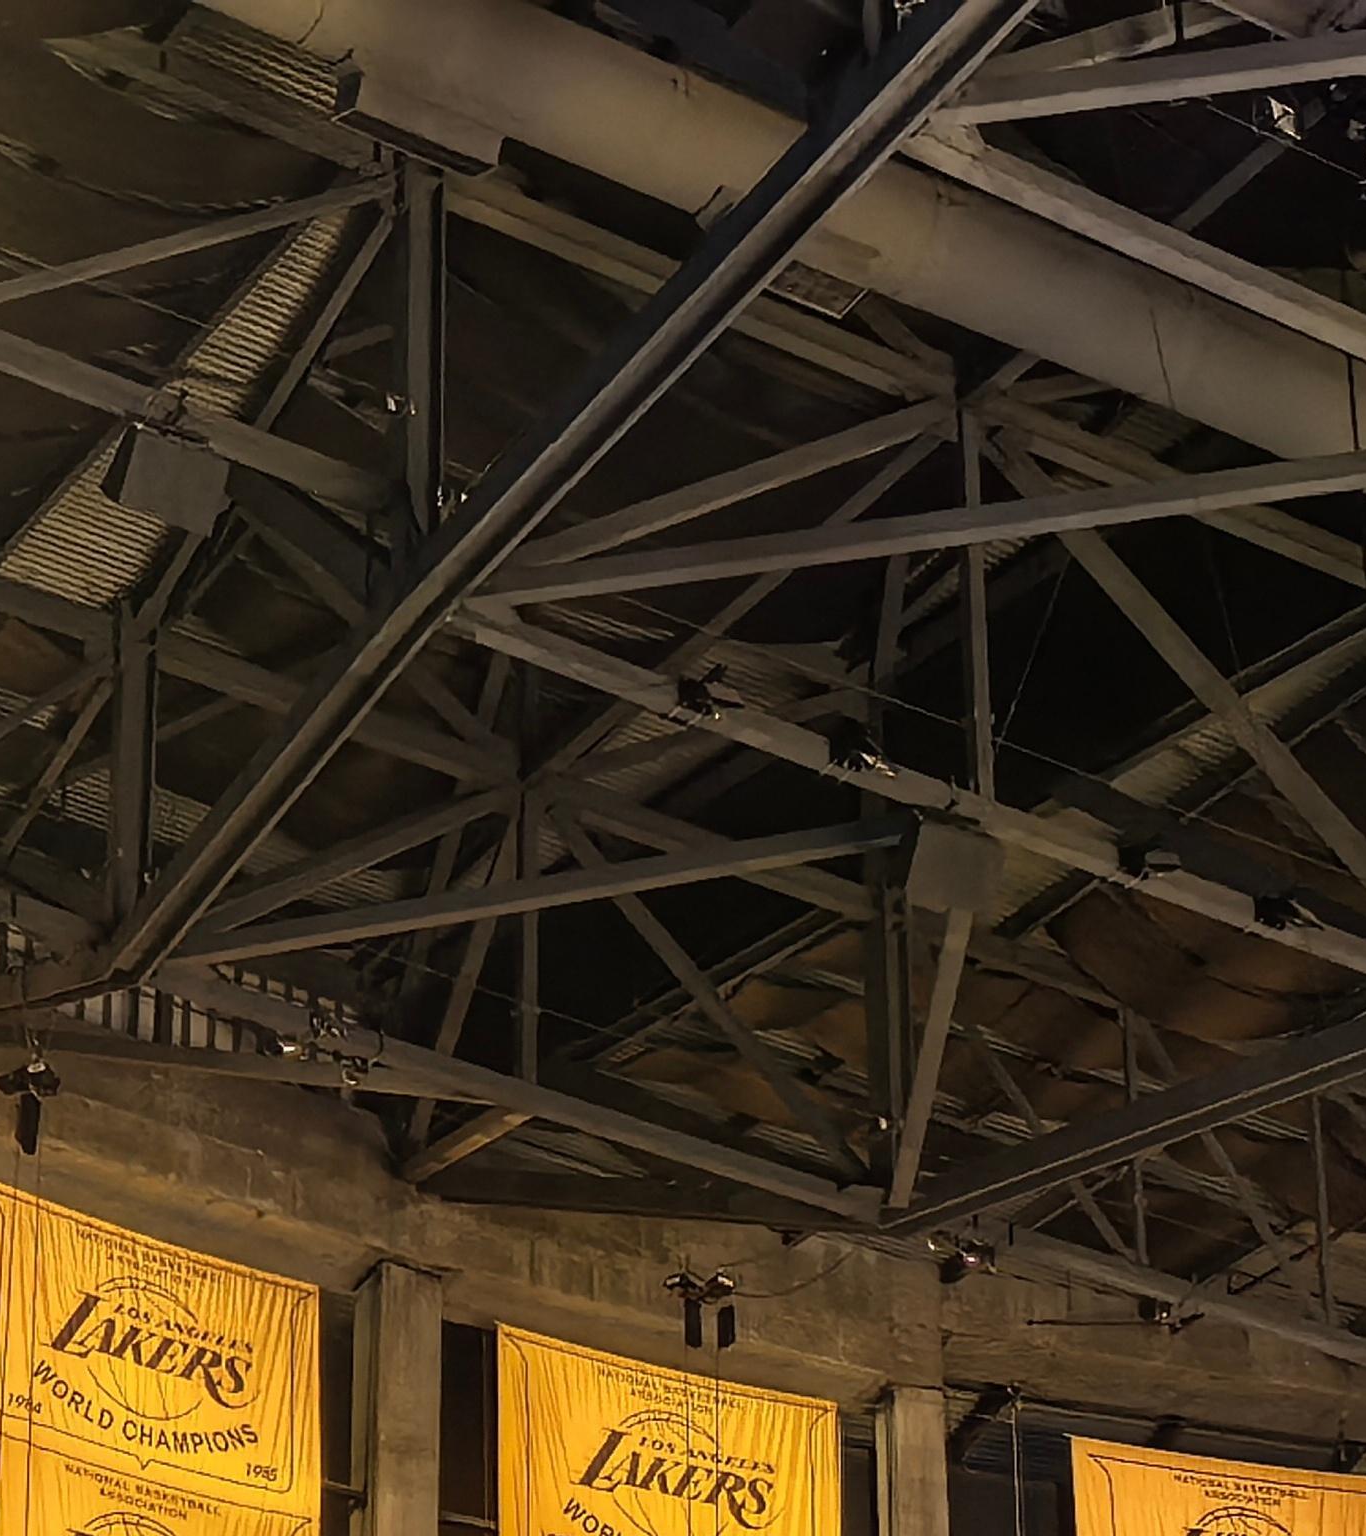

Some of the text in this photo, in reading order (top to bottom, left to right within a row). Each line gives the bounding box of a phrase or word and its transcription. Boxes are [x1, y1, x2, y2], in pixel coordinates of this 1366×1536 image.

[42, 1291, 260, 1408] LAKERS
[34, 1360, 258, 1454] WORLD CHAMPIONS
[569, 1427, 785, 1529] LAKERS
